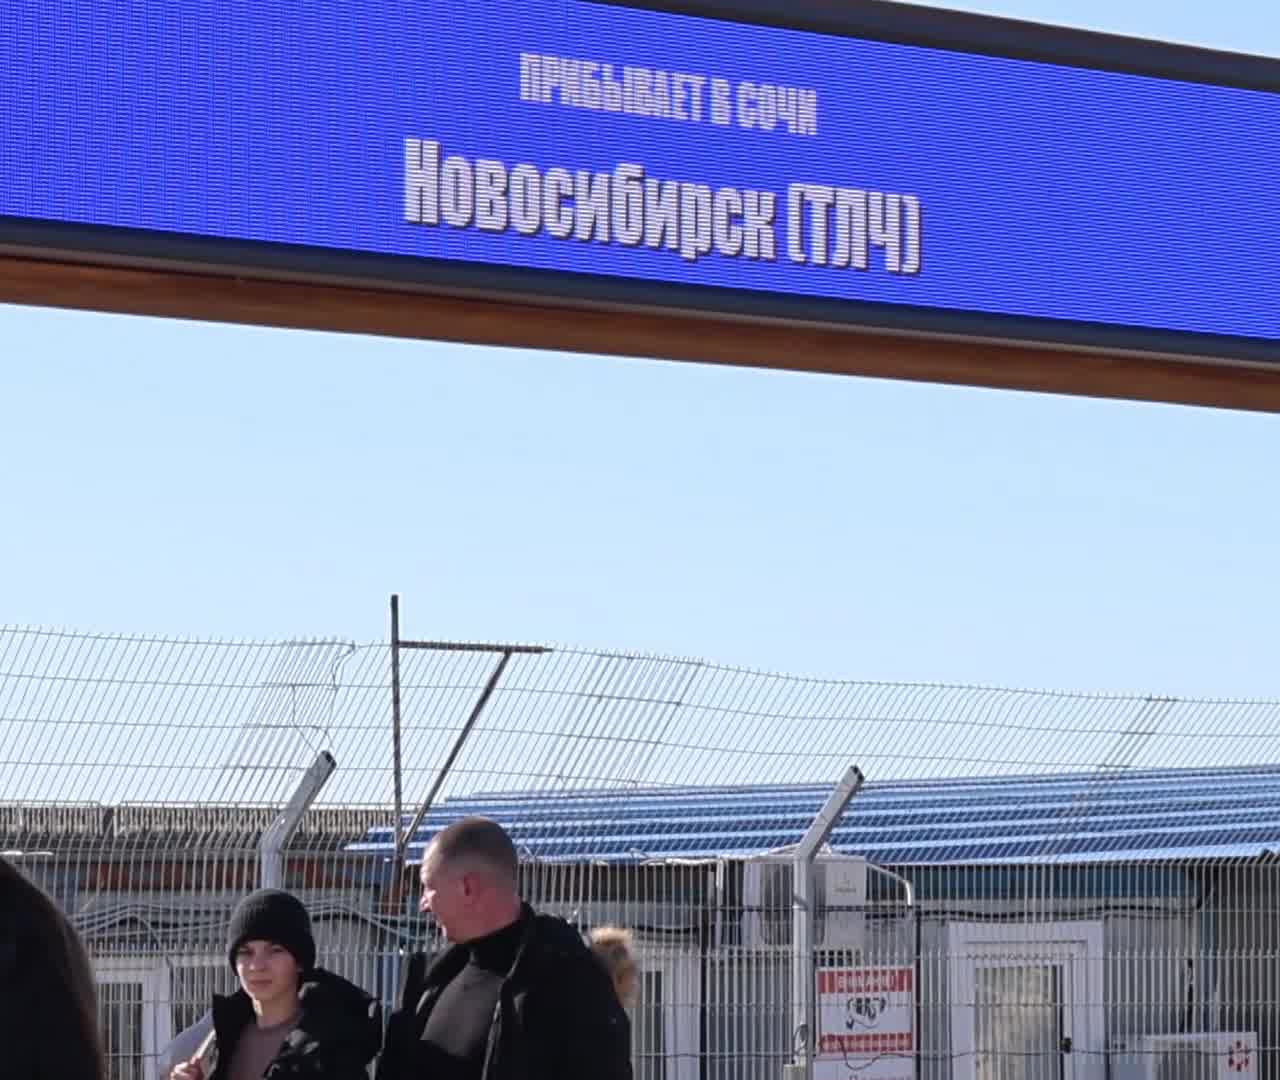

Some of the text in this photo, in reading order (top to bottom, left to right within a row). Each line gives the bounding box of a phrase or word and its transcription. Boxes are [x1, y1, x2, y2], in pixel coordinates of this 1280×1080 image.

[520, 52, 817, 135] ПРИБЫВАЕТ В СОЧИ
[404, 138, 776, 260] Новосибирск
